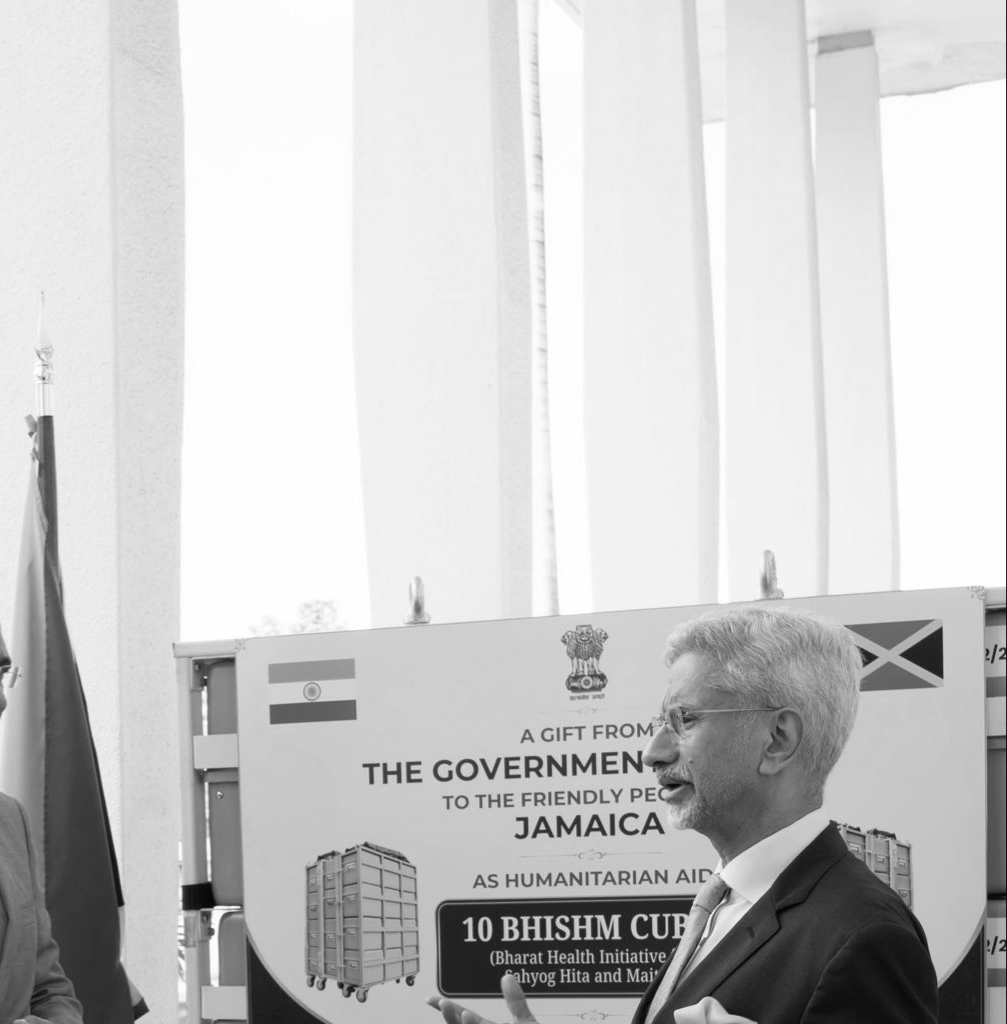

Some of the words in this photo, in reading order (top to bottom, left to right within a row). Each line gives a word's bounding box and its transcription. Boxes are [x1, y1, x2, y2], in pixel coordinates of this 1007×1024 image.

[520, 728, 535, 744] A
[540, 725, 587, 743] GIFT
[592, 722, 654, 740] FROM
[361, 760, 423, 785] THE
[432, 751, 656, 782] GOVERNMEN
[441, 794, 470, 810] TO
[474, 792, 515, 809] THE
[521, 788, 624, 808] FRIENDLY
[514, 811, 666, 840] JAMAICA
[472, 873, 499, 889] AS
[505, 869, 669, 888] HUMANITARIAN
[675, 868, 713, 884] AID
[462, 916, 493, 942] 10
[500, 914, 622, 942] BHISHM
[489, 949, 543, 967] (Bharat
[547, 948, 596, 965] Health
[599, 948, 667, 964] Initiative
[560, 968, 590, 983] Hita
[594, 967, 622, 983] and
